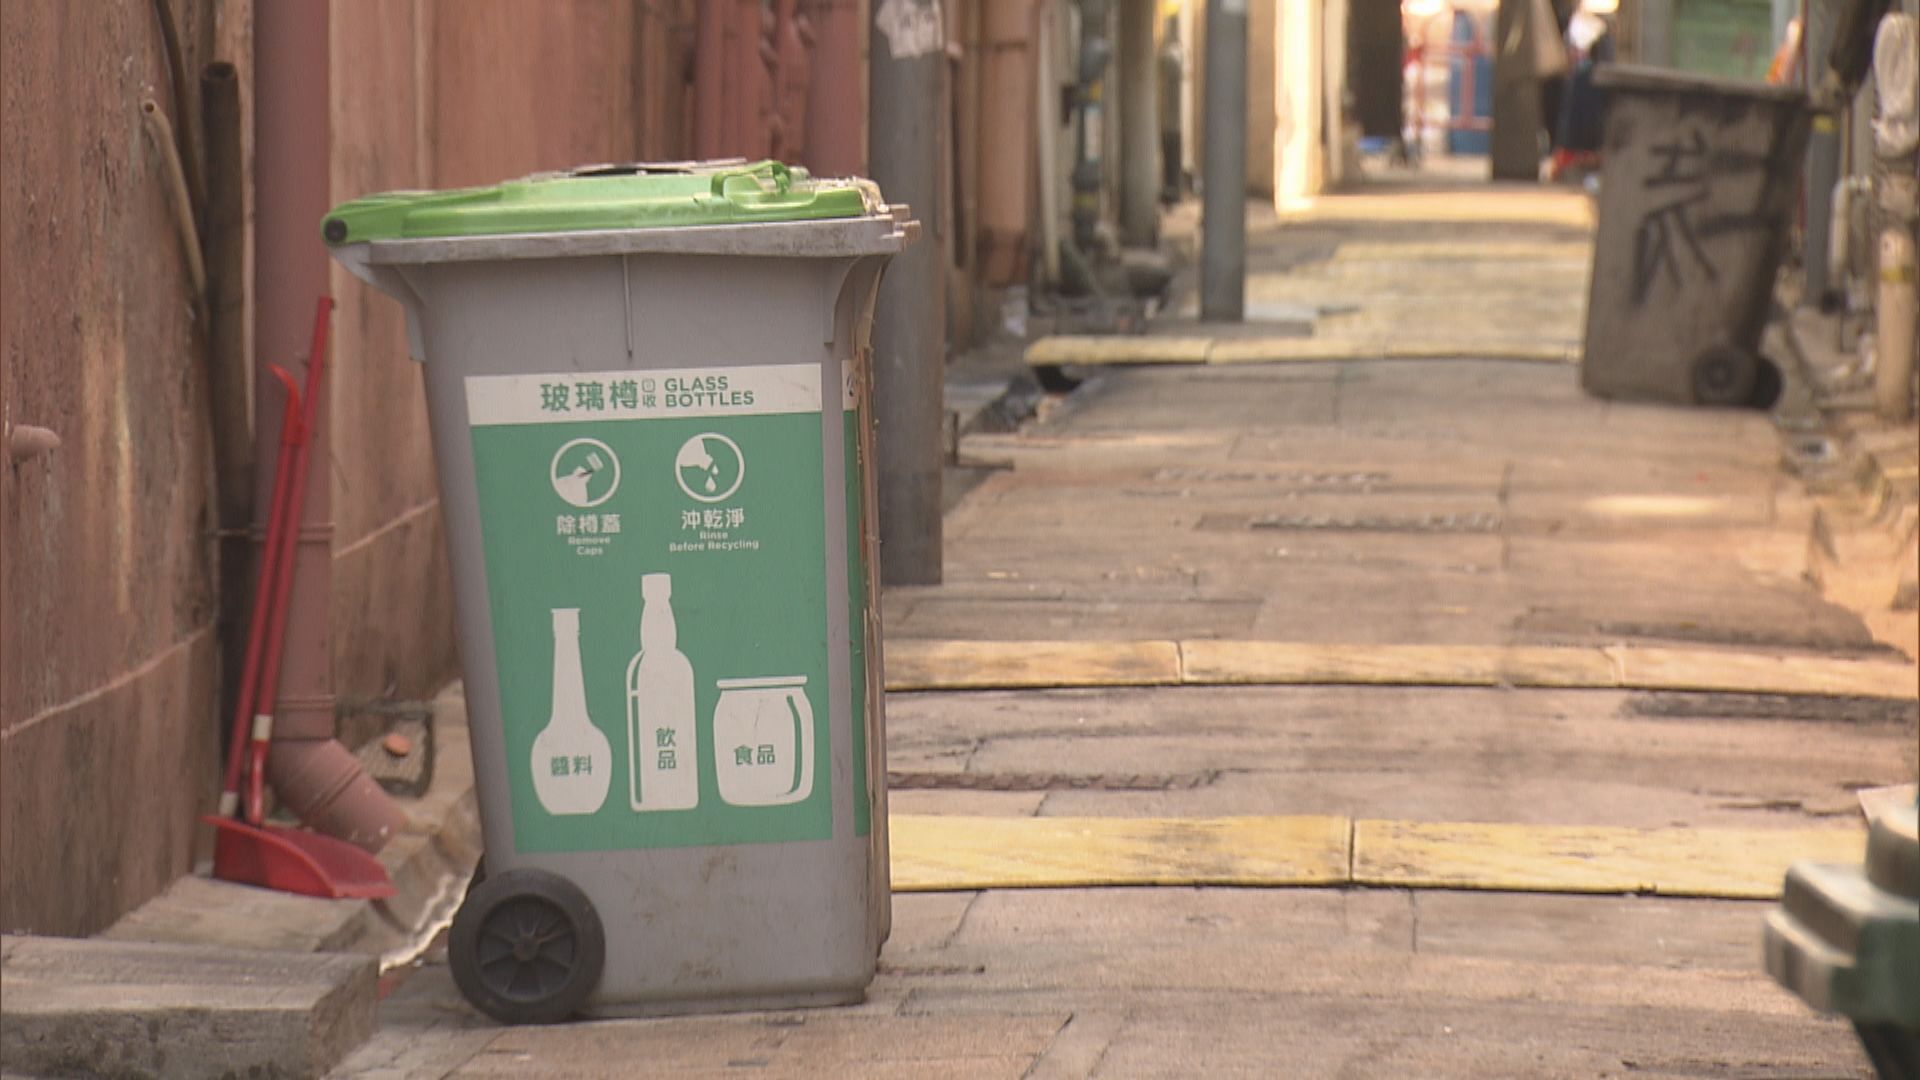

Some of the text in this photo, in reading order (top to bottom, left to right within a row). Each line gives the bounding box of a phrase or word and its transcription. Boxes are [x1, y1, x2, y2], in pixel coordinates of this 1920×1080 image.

[664, 376, 729, 392] GLASS
[540, 380, 639, 412] 玻璃樽
[665, 391, 754, 408] BOTTLES
[556, 514, 621, 535] 除樽蓋
[681, 508, 745, 530] 沖乾淨
[568, 536, 611, 545] Remove
[699, 531, 728, 540] Rinse
[576, 546, 603, 556] Caps
[669, 540, 760, 552] Before Recycling
[655, 727, 677, 770] 飲品
[734, 744, 776, 766] 食品
